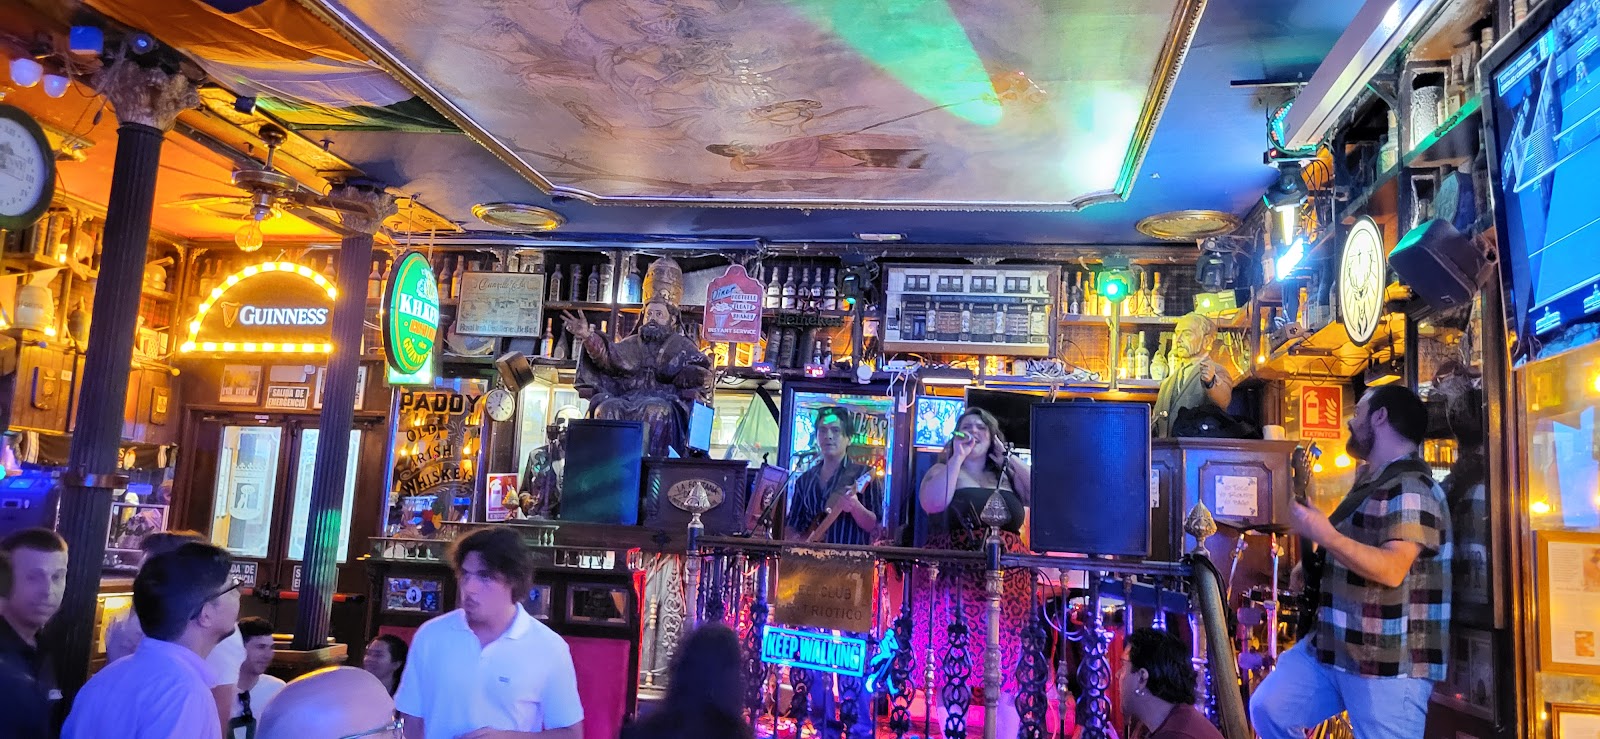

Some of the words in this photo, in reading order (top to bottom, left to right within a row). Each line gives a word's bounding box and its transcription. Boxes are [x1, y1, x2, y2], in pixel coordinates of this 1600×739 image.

[239, 305, 327, 325] GUINNESS
[779, 314, 844, 327] Heineken
[268, 398, 305, 407] EMERGENCIA
[272, 389, 293, 398] SALIDA
[295, 389, 304, 398] DE
[400, 394, 481, 414] PADDY
[406, 424, 438, 442] OLD
[1304, 430, 1338, 438] EXTINTOR
[410, 444, 454, 469] IRISH
[402, 466, 474, 496] WHISKEY
[245, 564, 254, 573] DE
[821, 587, 852, 600] CLUB
[803, 604, 862, 622] TRIOTICO
[767, 633, 799, 660] KEEP
[801, 638, 860, 669] WALKING
